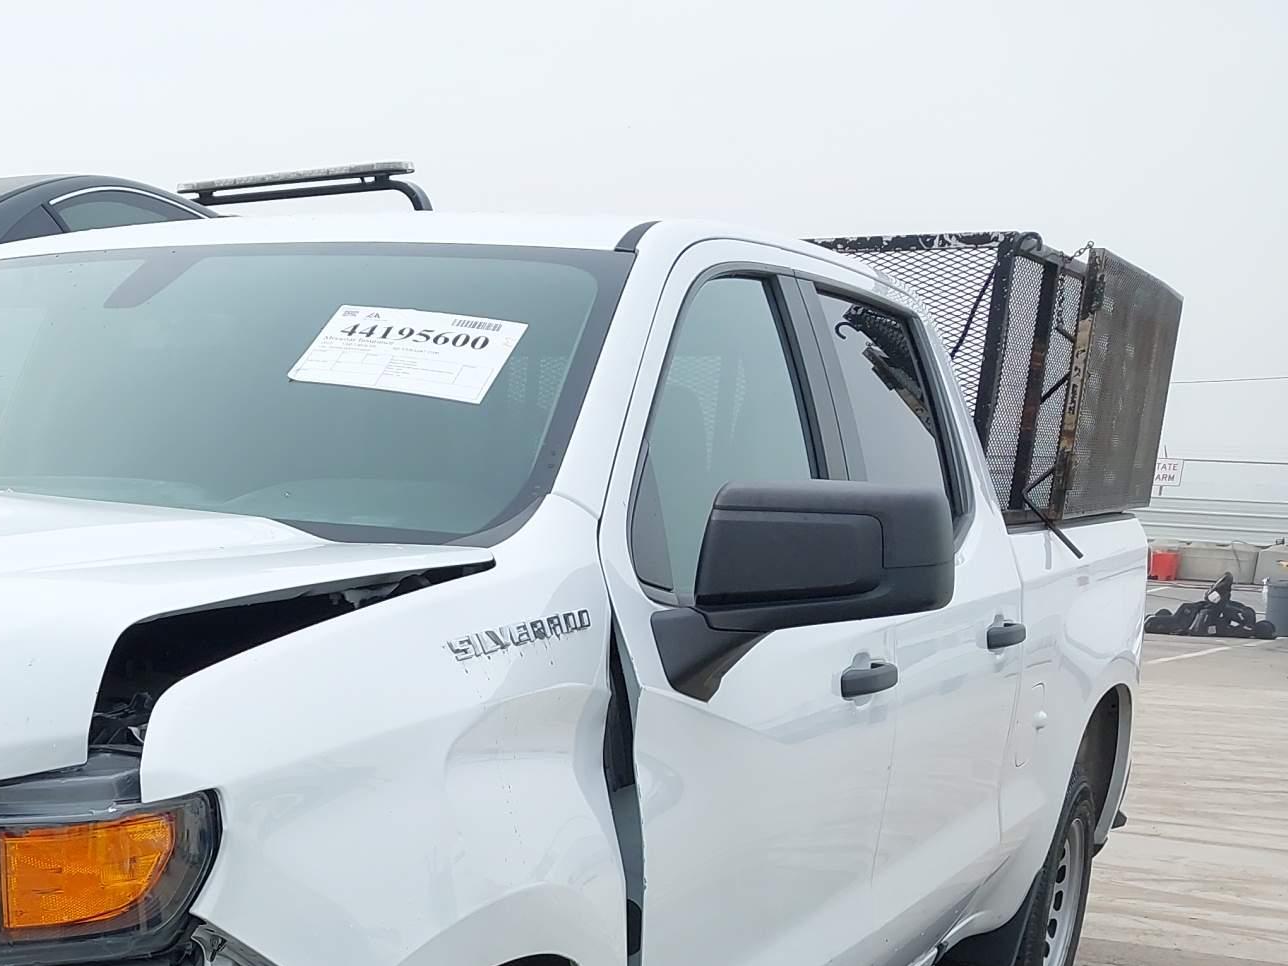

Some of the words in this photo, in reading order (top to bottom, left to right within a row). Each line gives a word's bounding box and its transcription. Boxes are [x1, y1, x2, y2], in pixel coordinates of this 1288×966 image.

[340, 323, 490, 350] 44195600
[1156, 462, 1179, 471] TATE
[1154, 473, 1175, 482] ARM
[447, 608, 592, 661] SILVERADO
